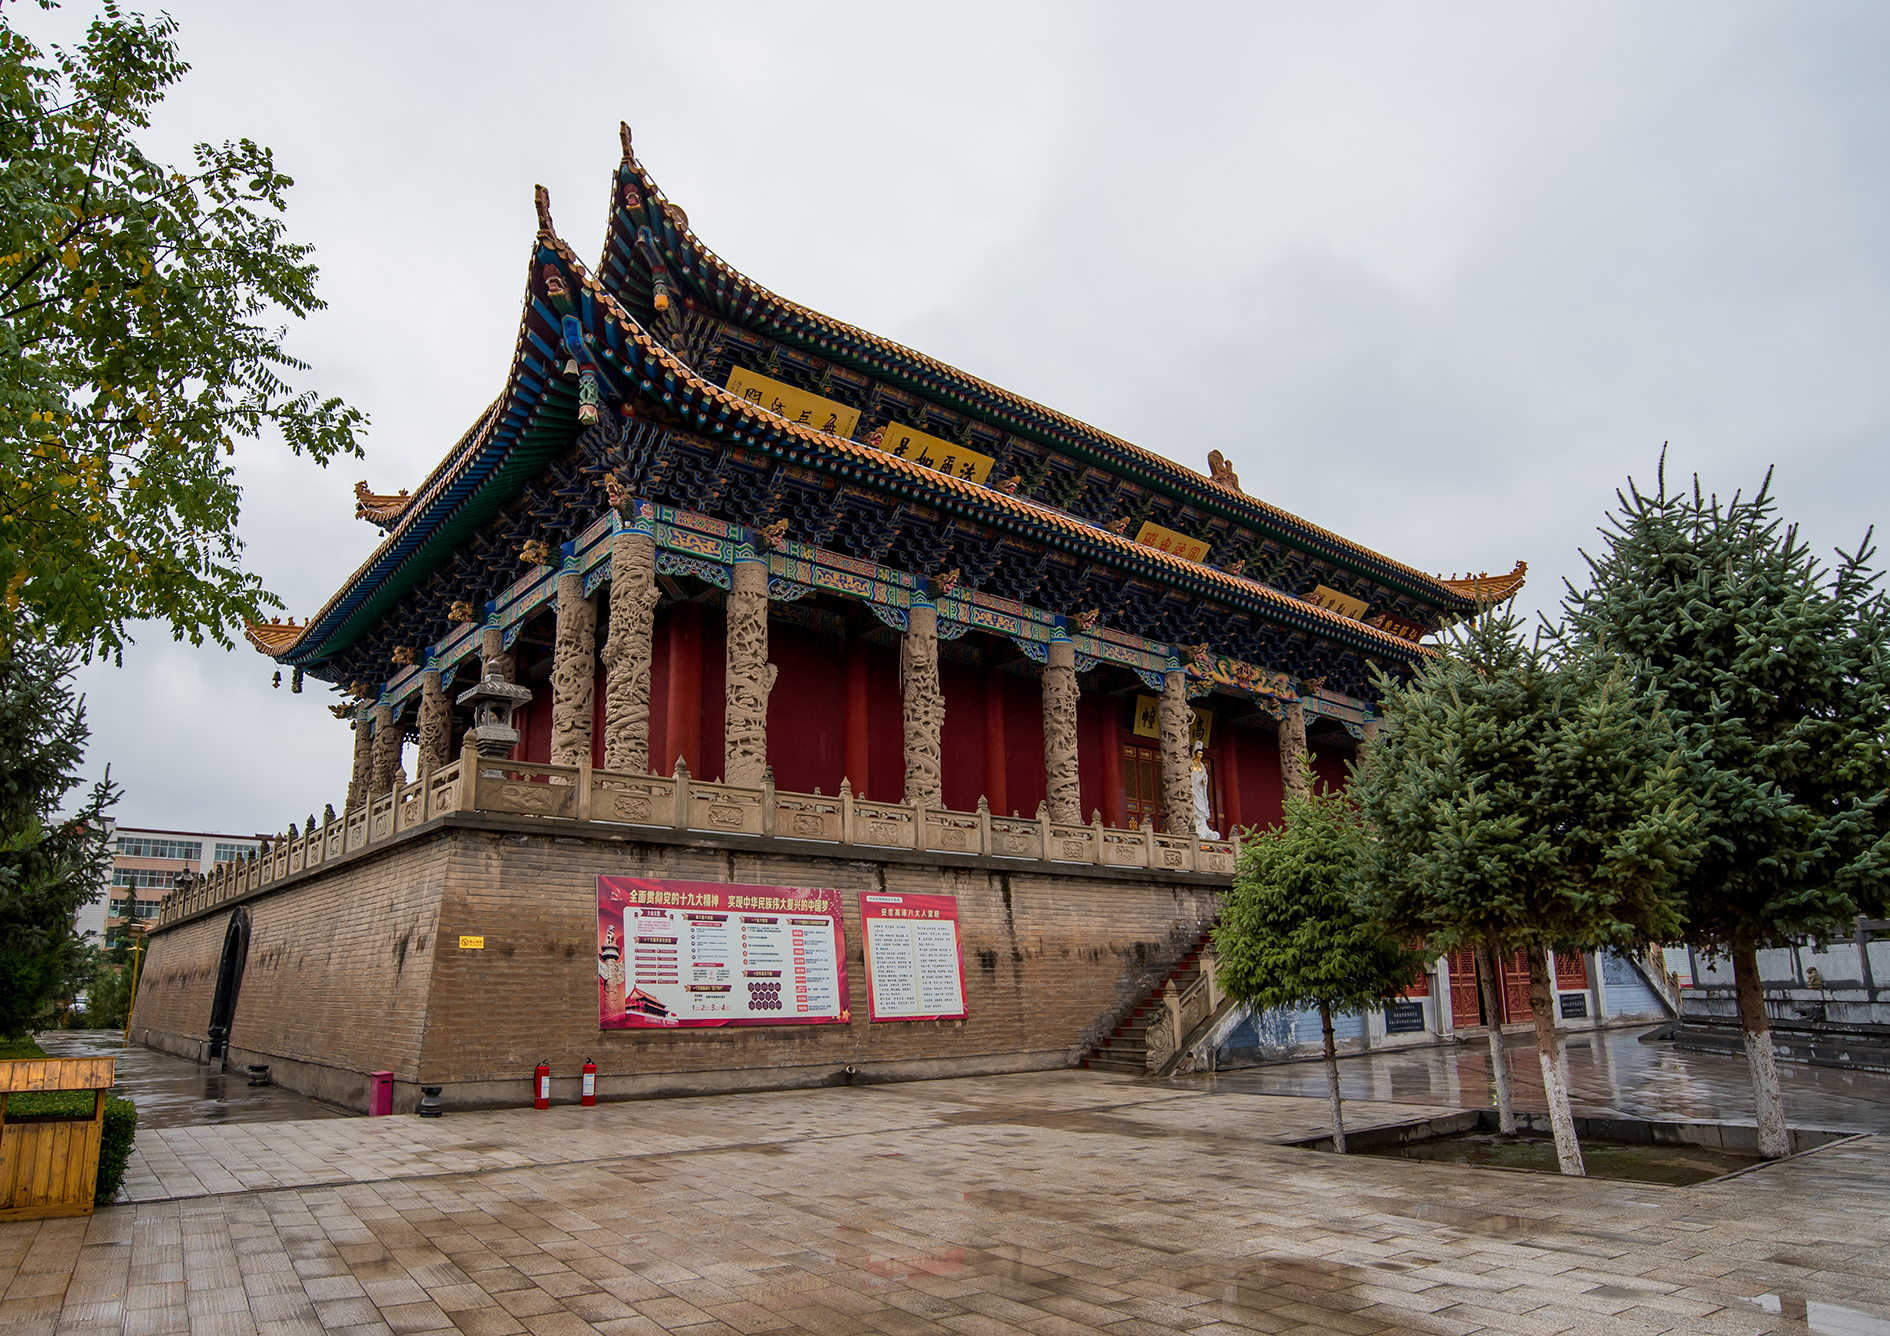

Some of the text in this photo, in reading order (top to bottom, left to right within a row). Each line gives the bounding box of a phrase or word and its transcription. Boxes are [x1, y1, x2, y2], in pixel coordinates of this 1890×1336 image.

[629, 889, 829, 912] 全面贯彻党的十九大精神 实现中华民族伟大复兴的中国梦
